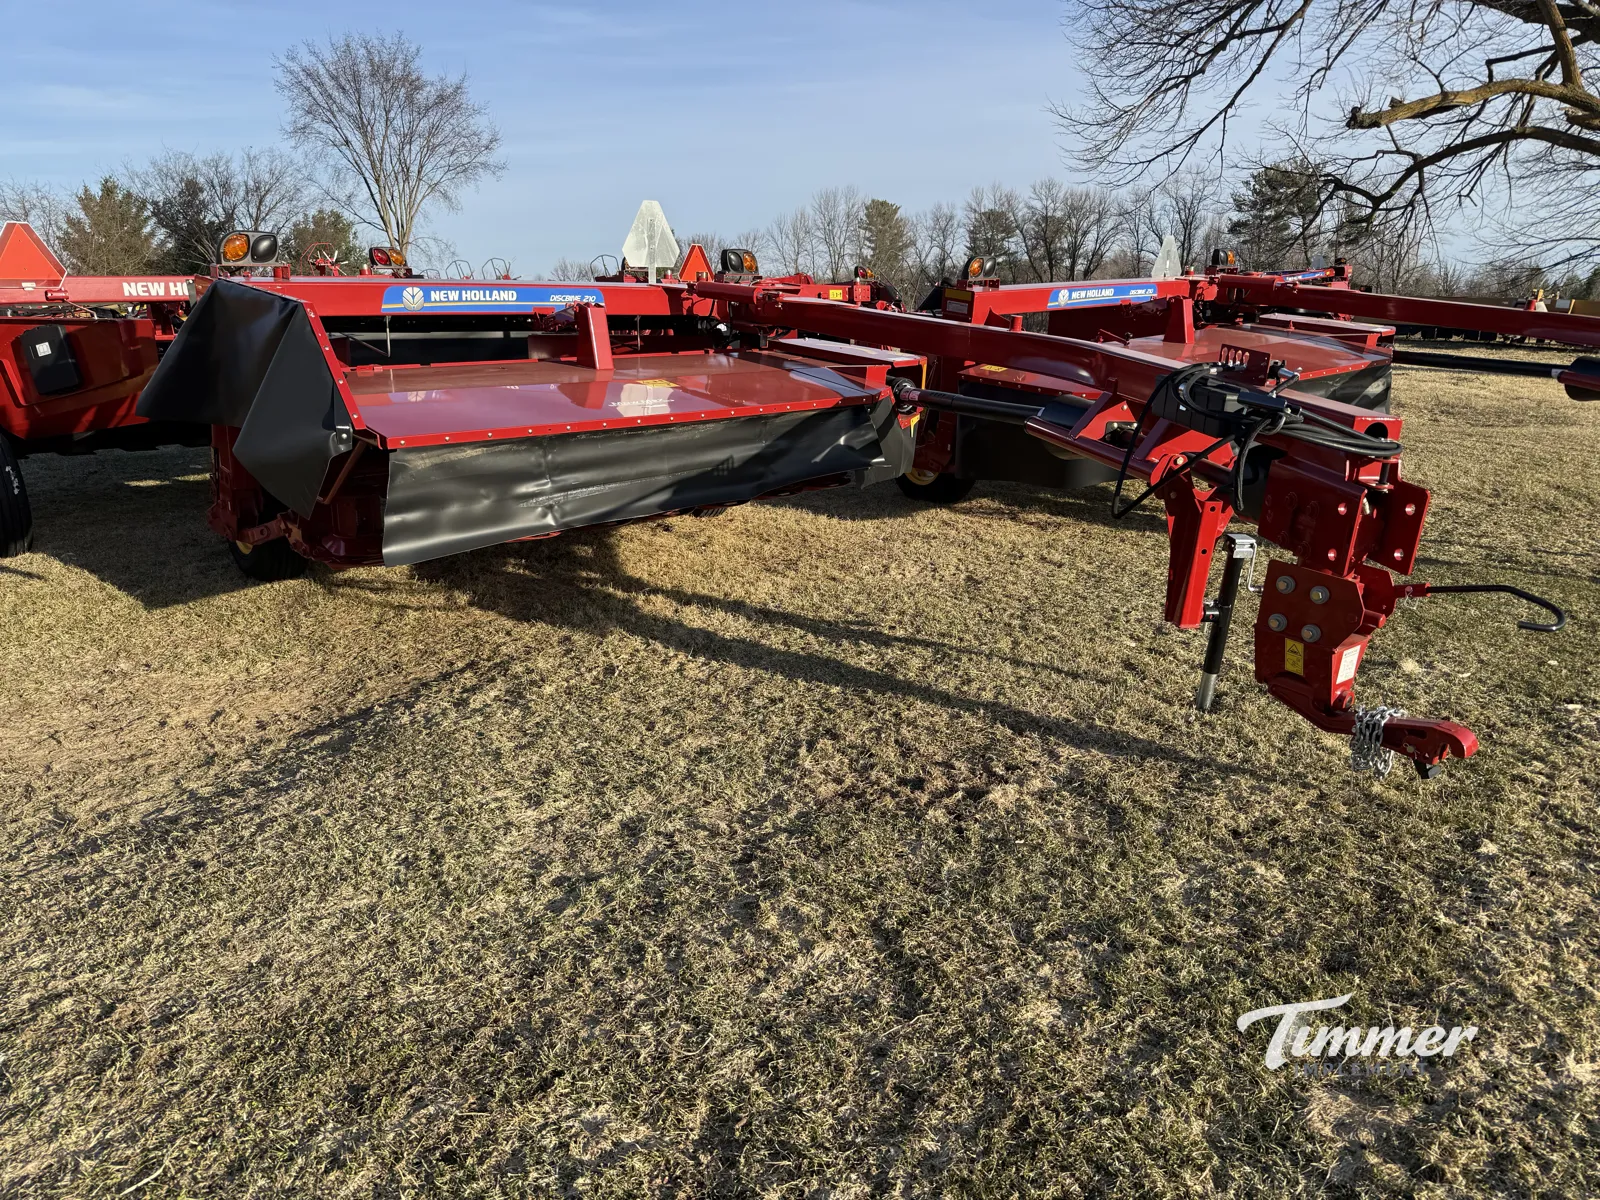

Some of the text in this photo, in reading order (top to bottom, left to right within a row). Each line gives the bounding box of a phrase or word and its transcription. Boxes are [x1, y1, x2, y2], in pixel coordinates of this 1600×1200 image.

[122, 282, 165, 296] NEW
[1071, 288, 1115, 300] NEW HOLLAND
[430, 290, 517, 302] NEW HOLLAND
